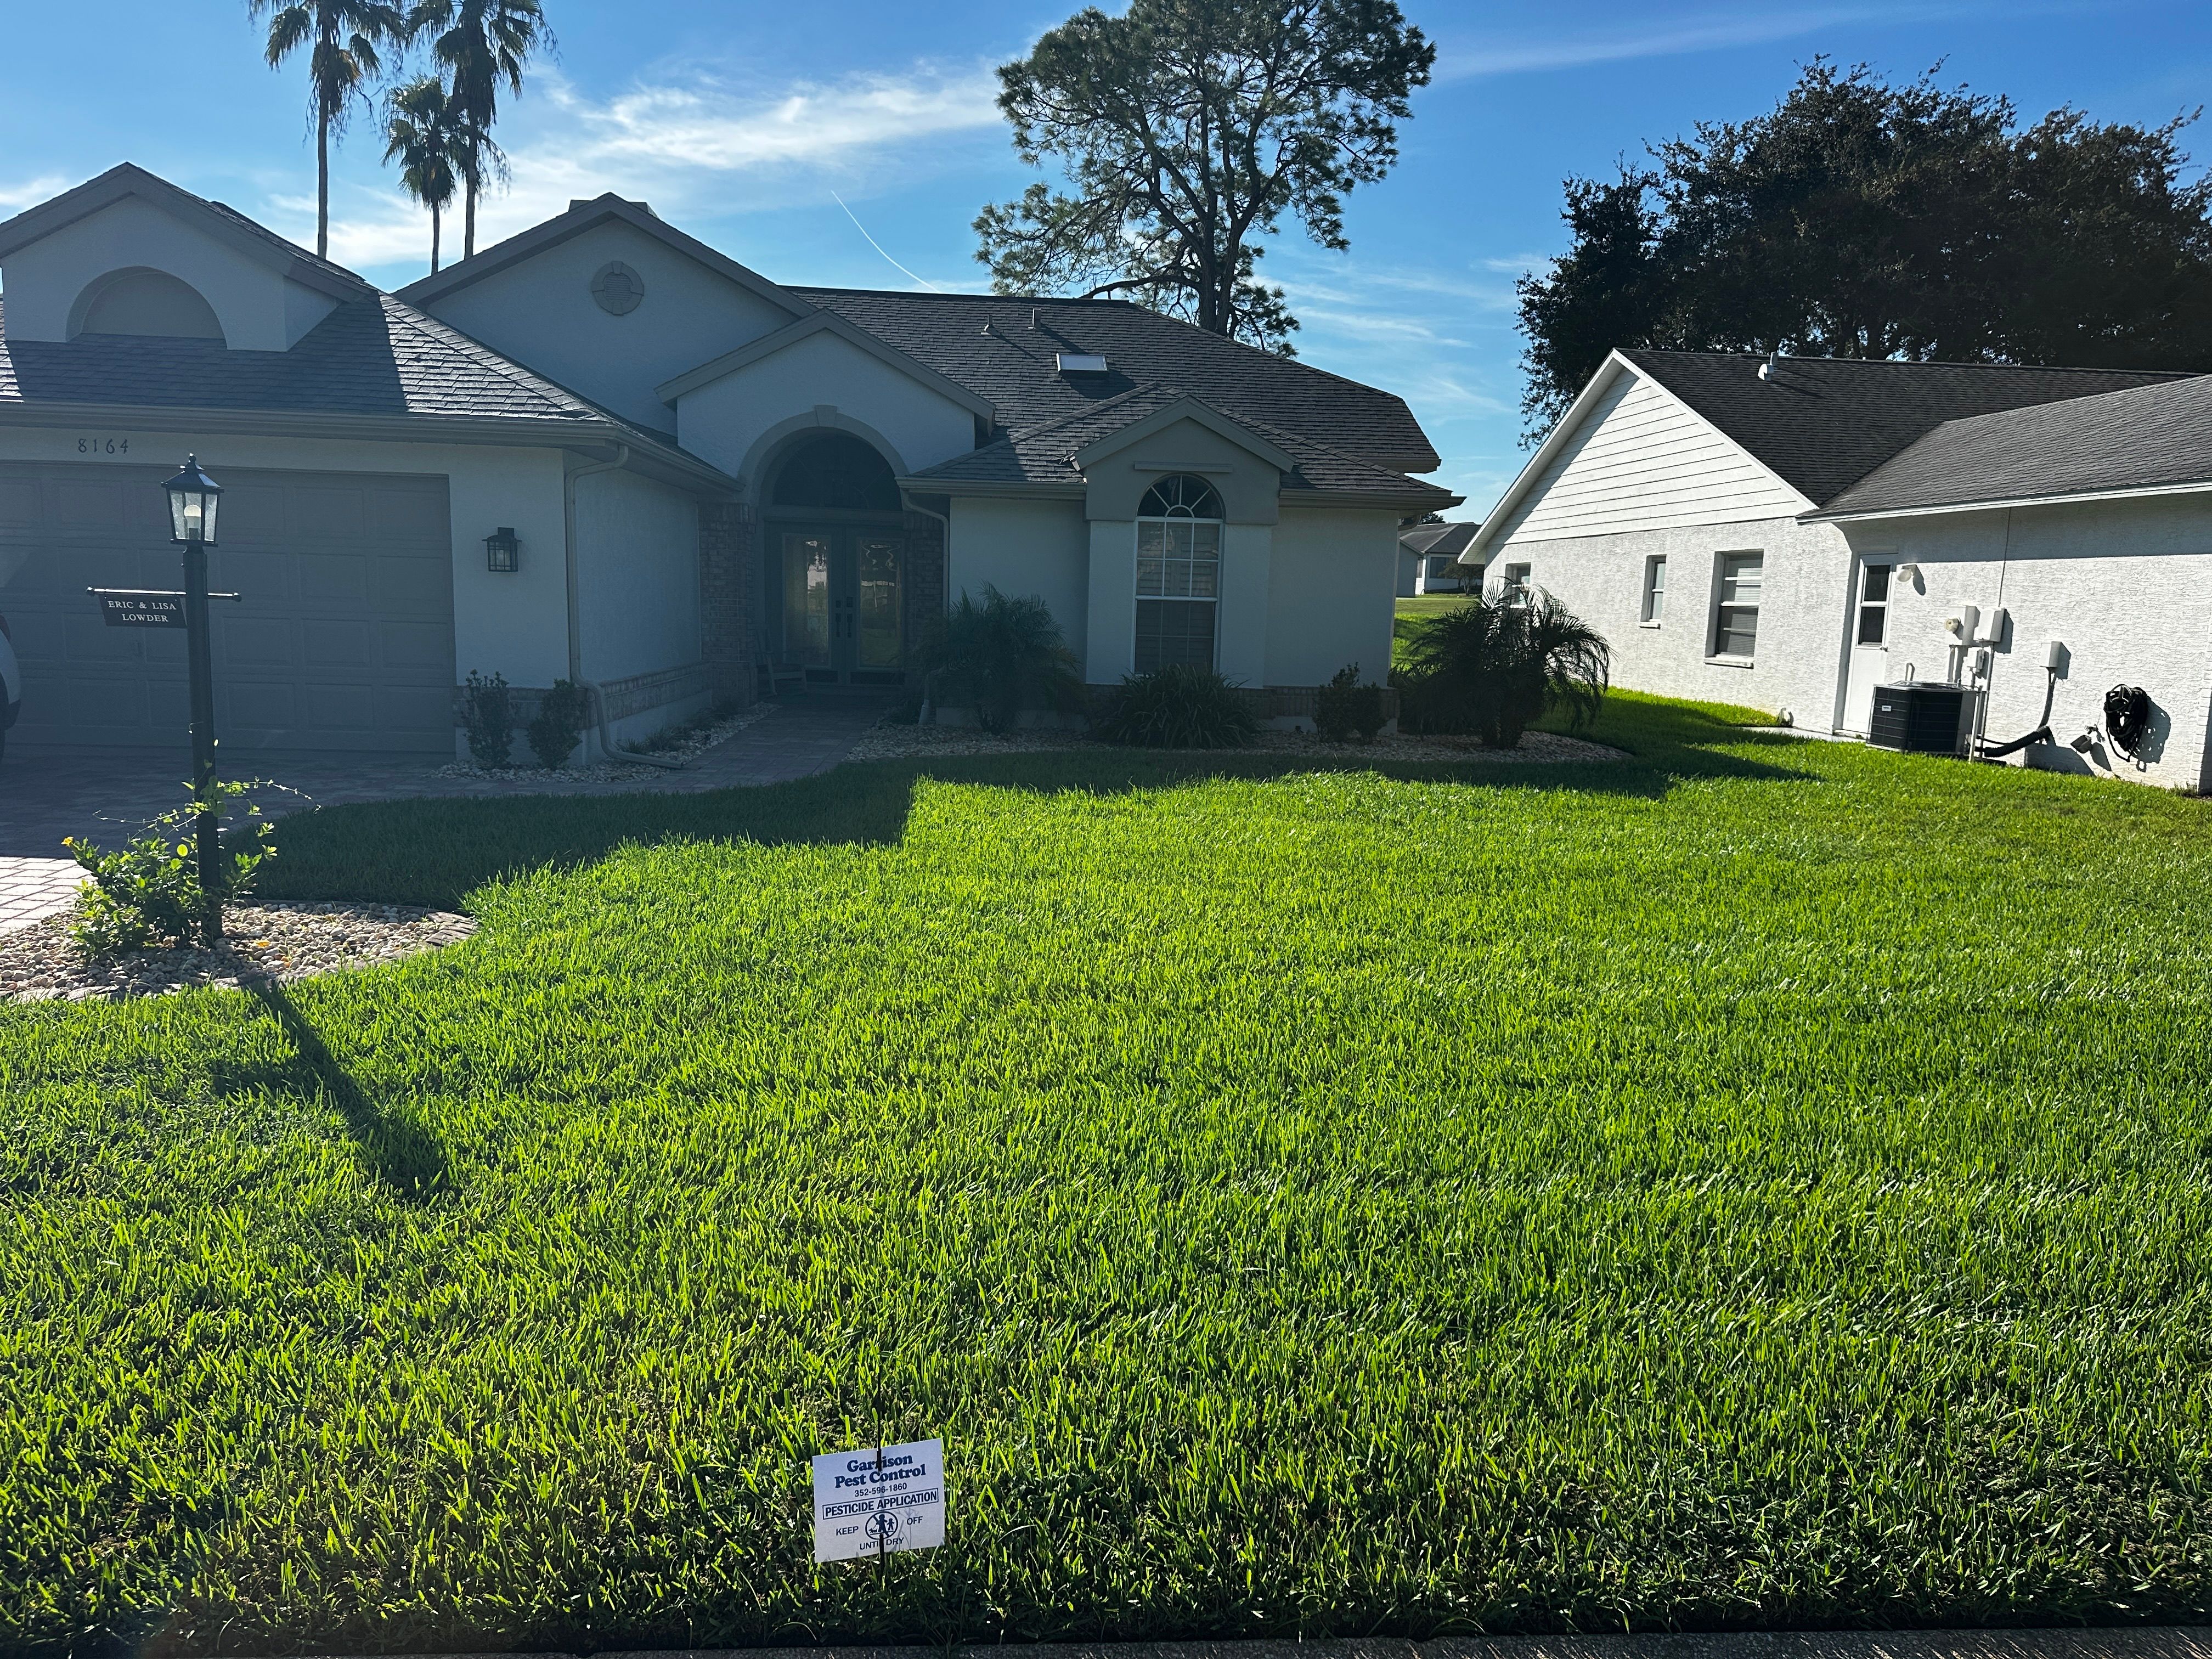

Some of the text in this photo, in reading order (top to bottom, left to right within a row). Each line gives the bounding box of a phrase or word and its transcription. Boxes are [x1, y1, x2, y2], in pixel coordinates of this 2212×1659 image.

[78, 438, 128, 454] 8164
[122, 613, 168, 622] LOWDER
[834, 1464, 926, 1488] Pest Control
[854, 1482, 907, 1497] 352-596-1860
[825, 1491, 936, 1516] PESTICIDE APPLICATION
[836, 1516, 923, 1536] KEEP OFF
[860, 1537, 904, 1550] UNTI DRY
